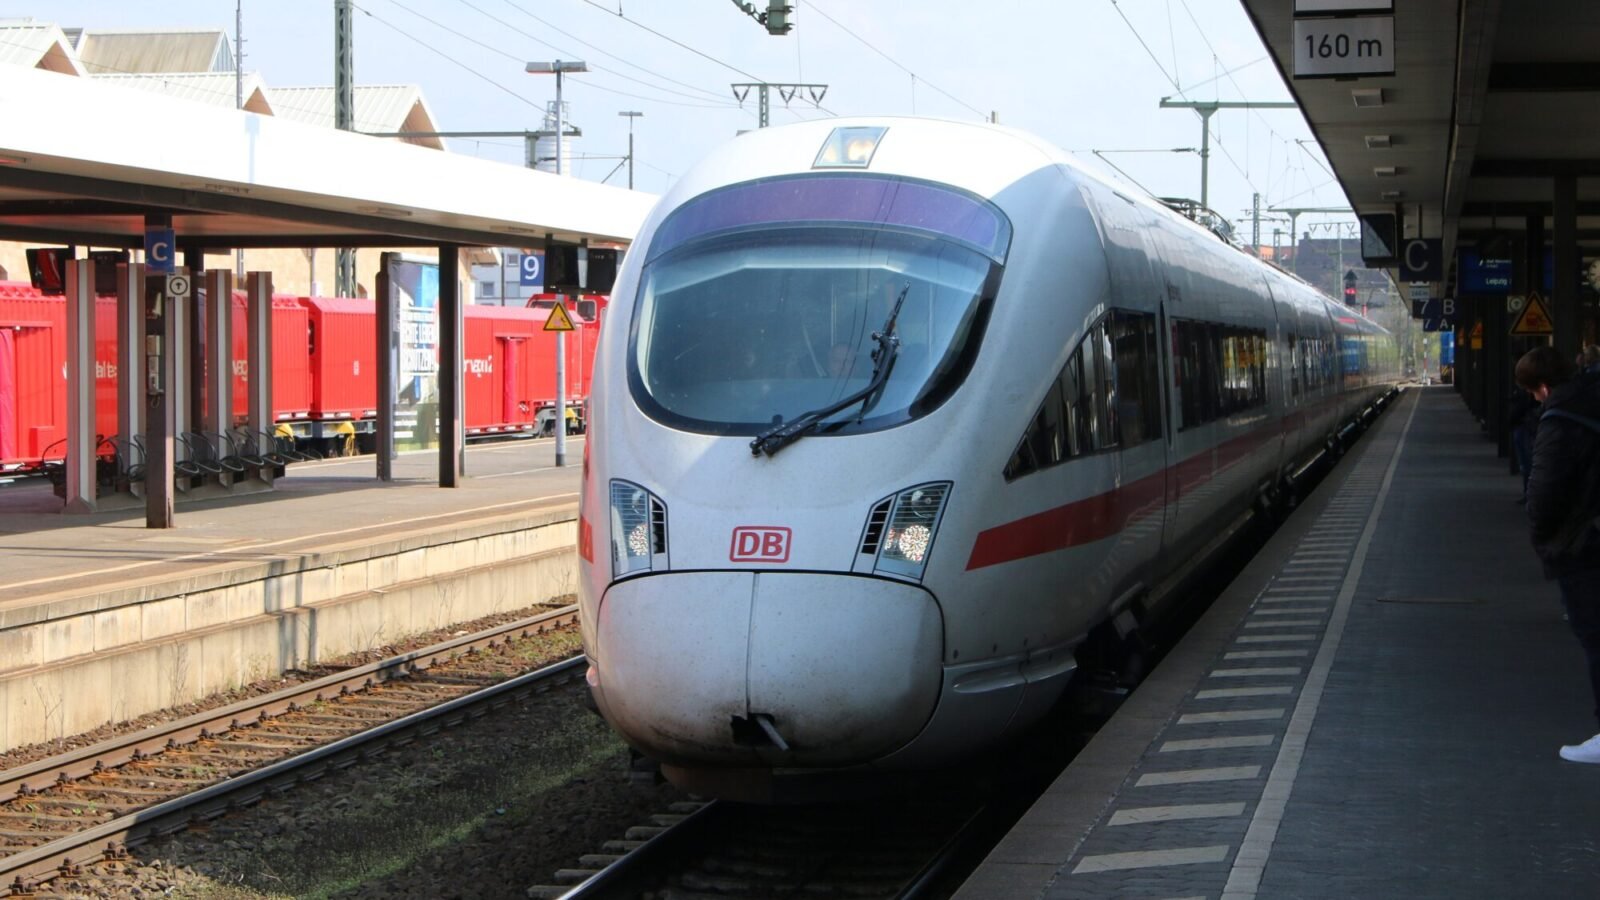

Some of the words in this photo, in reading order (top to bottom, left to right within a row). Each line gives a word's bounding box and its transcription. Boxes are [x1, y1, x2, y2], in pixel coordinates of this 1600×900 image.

[1305, 33, 1349, 58] 160
[1357, 39, 1382, 57] m
[152, 243, 168, 262] C
[1405, 240, 1429, 271] C
[523, 255, 540, 280] 9
[1485, 277, 1508, 287] Leipzig
[1419, 299, 1429, 315] 7
[1443, 299, 1455, 315] B
[1440, 318, 1448, 329] A
[737, 531, 783, 556] DB
